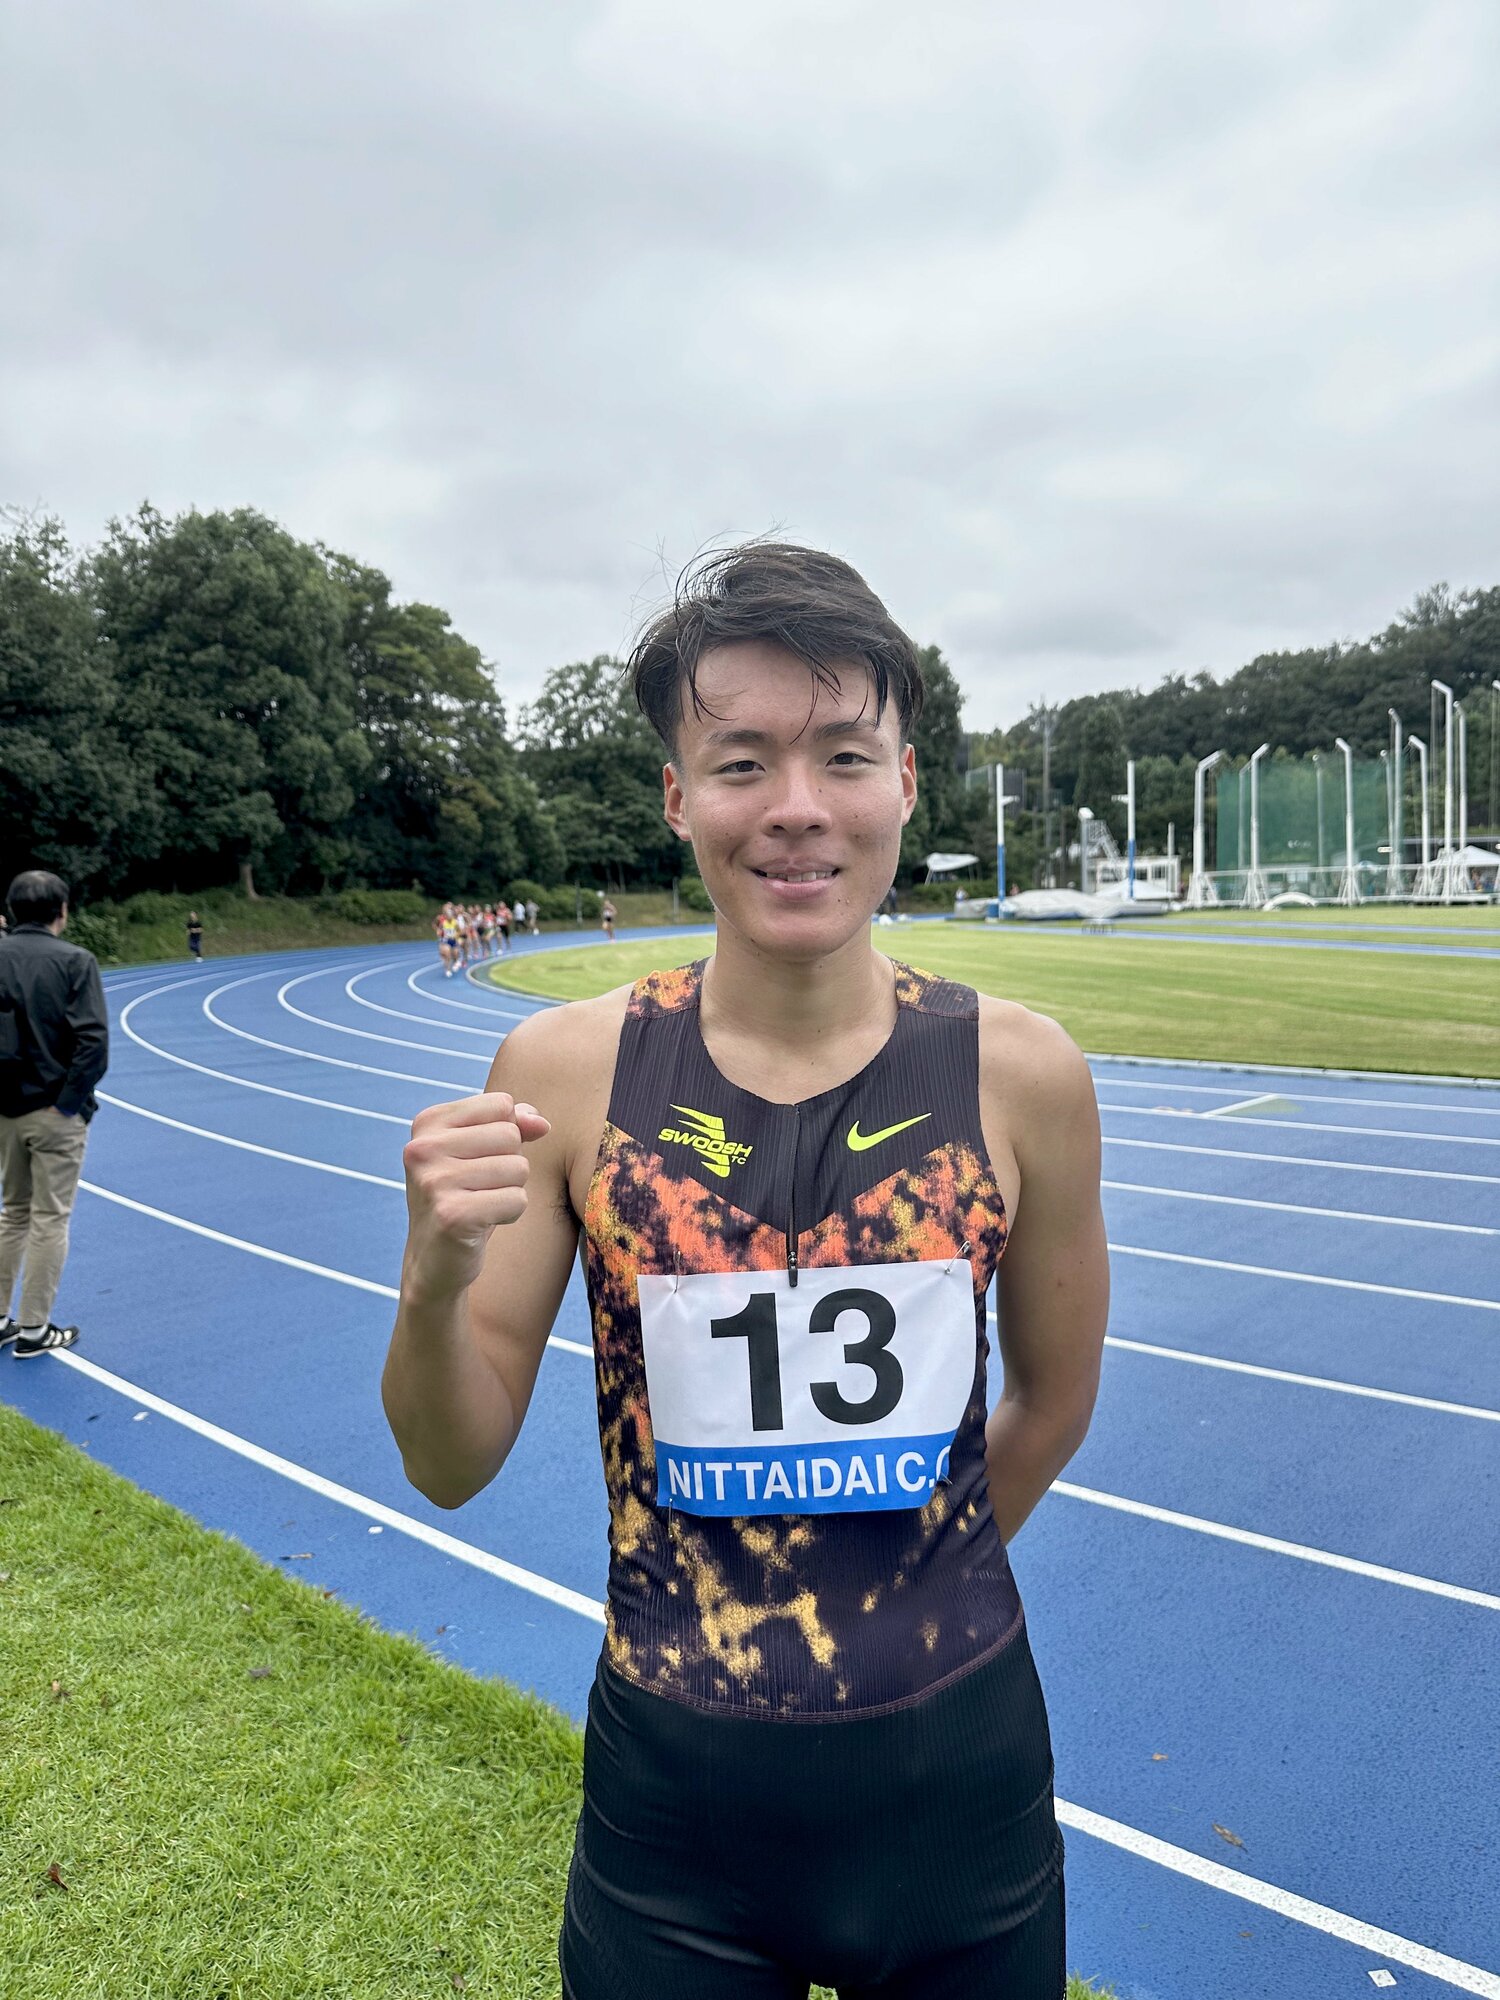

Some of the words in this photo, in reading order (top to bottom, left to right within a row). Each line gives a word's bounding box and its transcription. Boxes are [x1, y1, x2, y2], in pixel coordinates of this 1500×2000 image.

[658, 1128, 753, 1158] SWOOSH
[730, 1155, 747, 1166] TC
[710, 1288, 904, 1432] 13
[667, 1454, 888, 1501] NITTAIDAI
